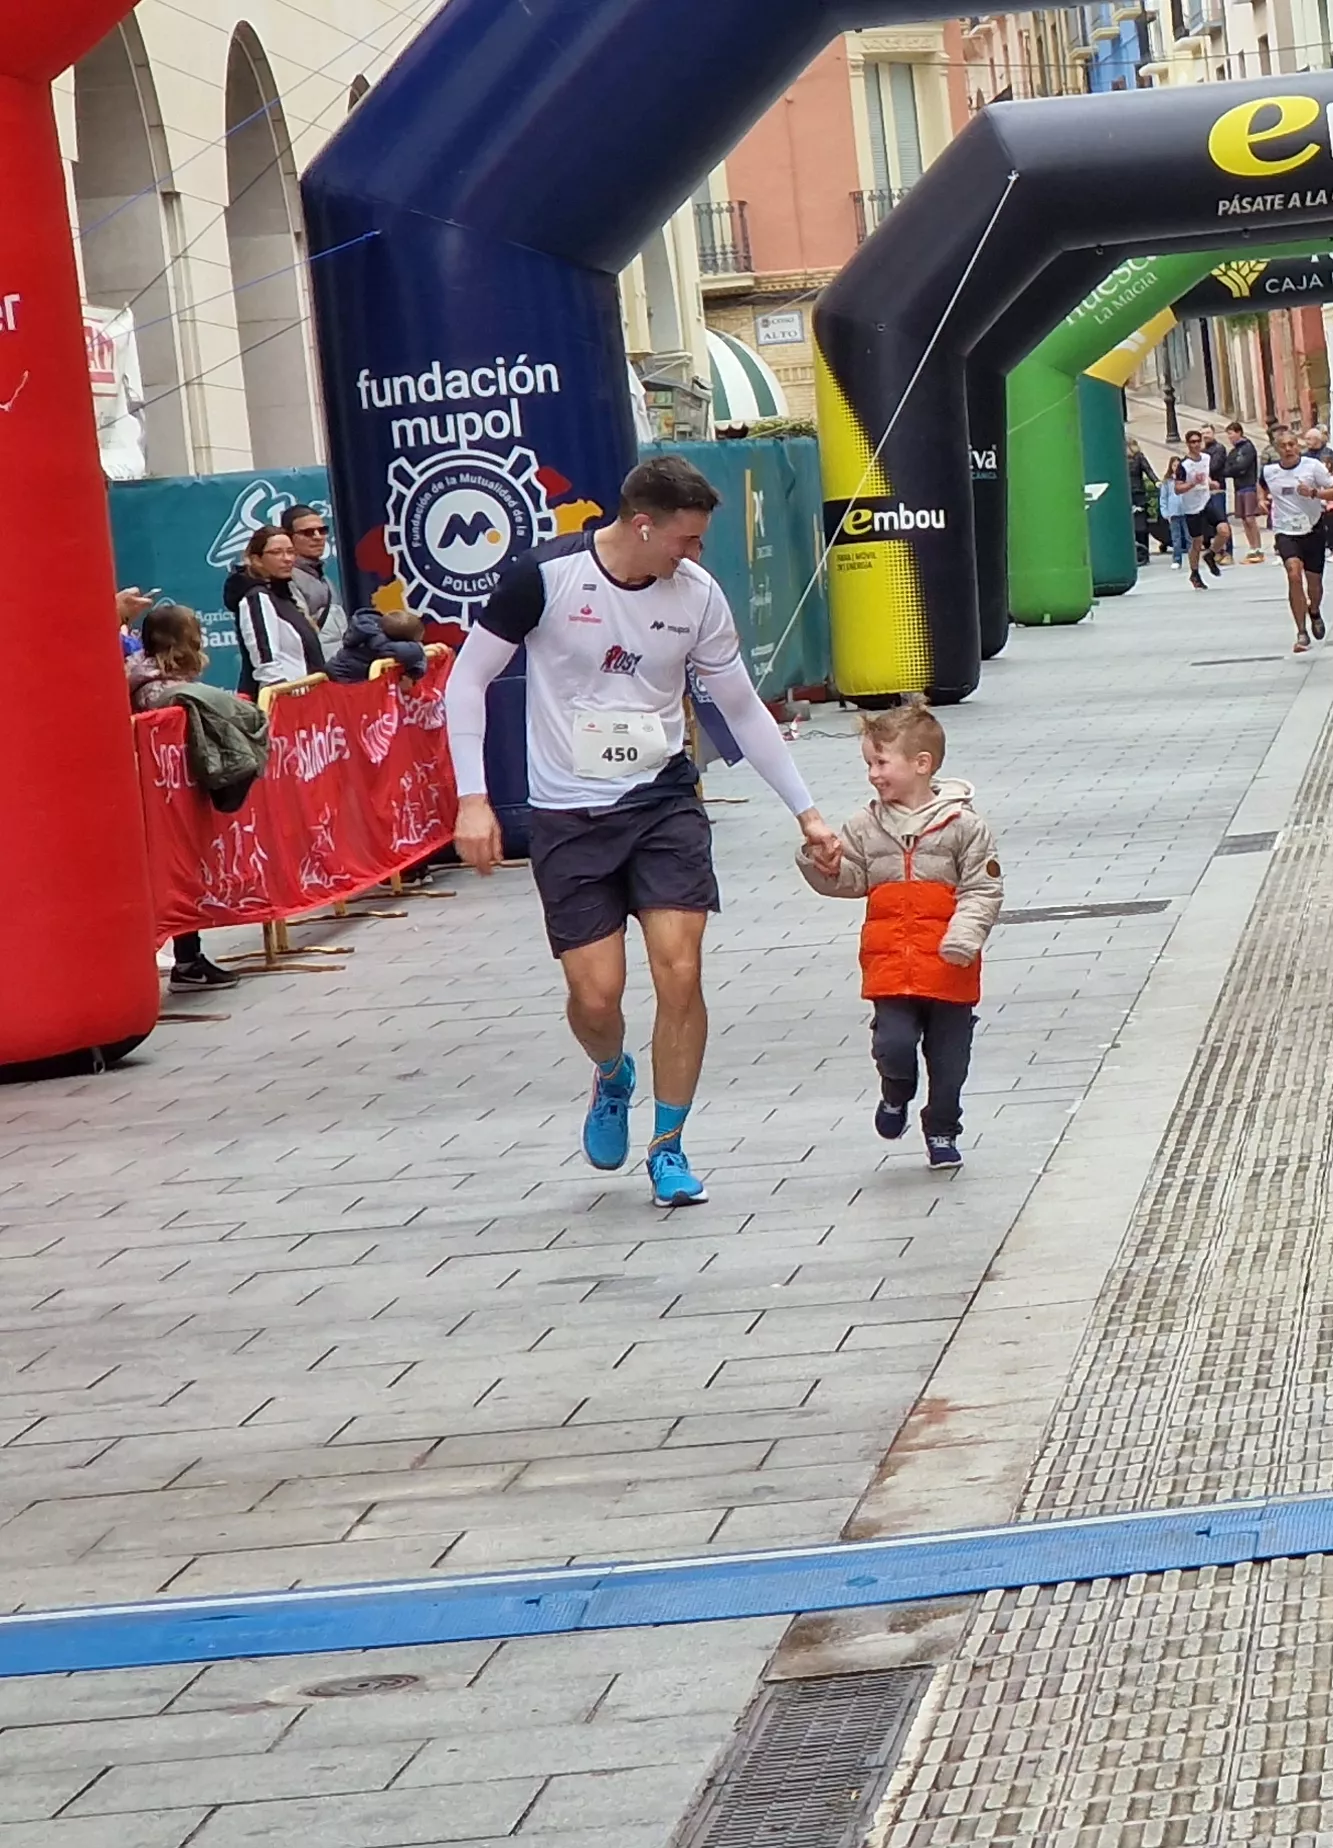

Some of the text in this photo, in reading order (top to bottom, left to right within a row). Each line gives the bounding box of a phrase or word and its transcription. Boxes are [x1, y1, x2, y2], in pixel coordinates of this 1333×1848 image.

[1217, 192, 1284, 217] PÁSATE
[1287, 193, 1301, 208] A
[1305, 190, 1328, 208] LA
[1264, 271, 1324, 294] CAJA
[763, 330, 798, 340] ALTO
[356, 354, 560, 410] fundación
[391, 398, 522, 450] mupol
[411, 493, 433, 548] Fundación
[431, 480, 445, 493] de
[445, 476, 458, 485] la
[459, 473, 518, 508] Mutualidad
[842, 502, 946, 535] embou
[441, 571, 501, 592] POLICÍA
[602, 747, 638, 762] 450
